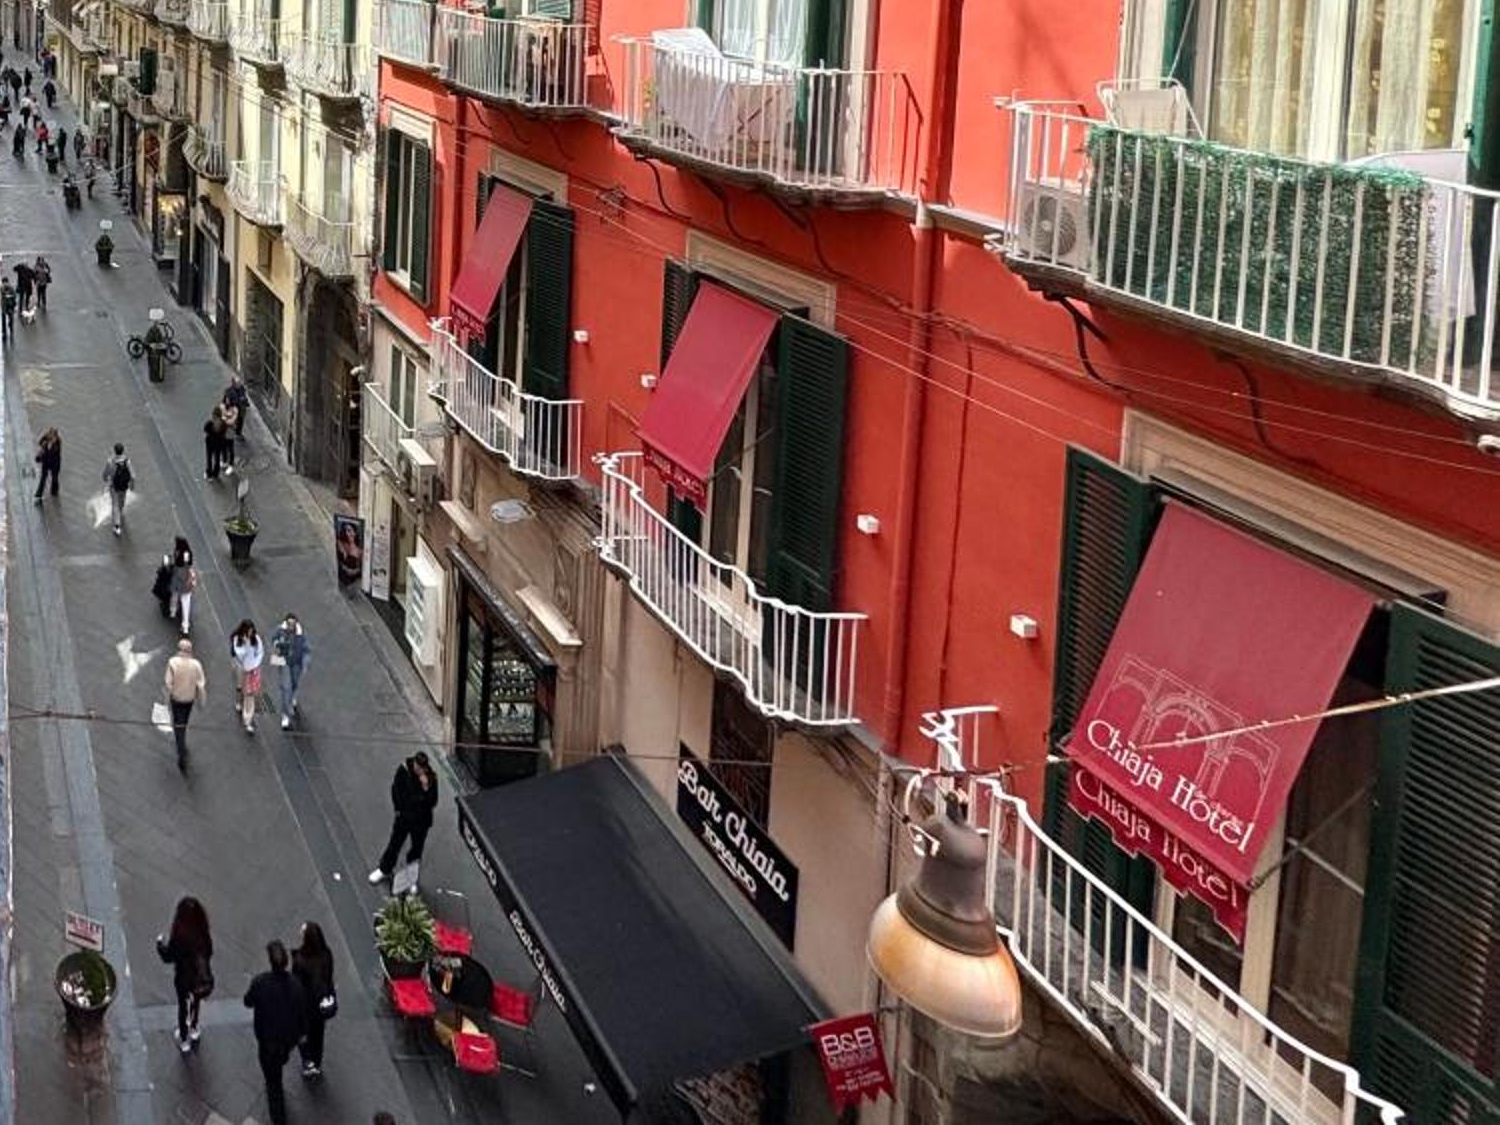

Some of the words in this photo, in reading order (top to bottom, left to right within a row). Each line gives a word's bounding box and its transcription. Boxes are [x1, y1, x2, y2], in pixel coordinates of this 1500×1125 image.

[677, 760, 722, 823] Bar
[725, 812, 789, 901] Chiaia
[1075, 768, 1151, 843] Chiaja
[1162, 829, 1238, 908] Hotel
[1088, 720, 1164, 791] Chiaja
[1170, 774, 1255, 853] Hotel
[821, 1025, 875, 1056] B&B
